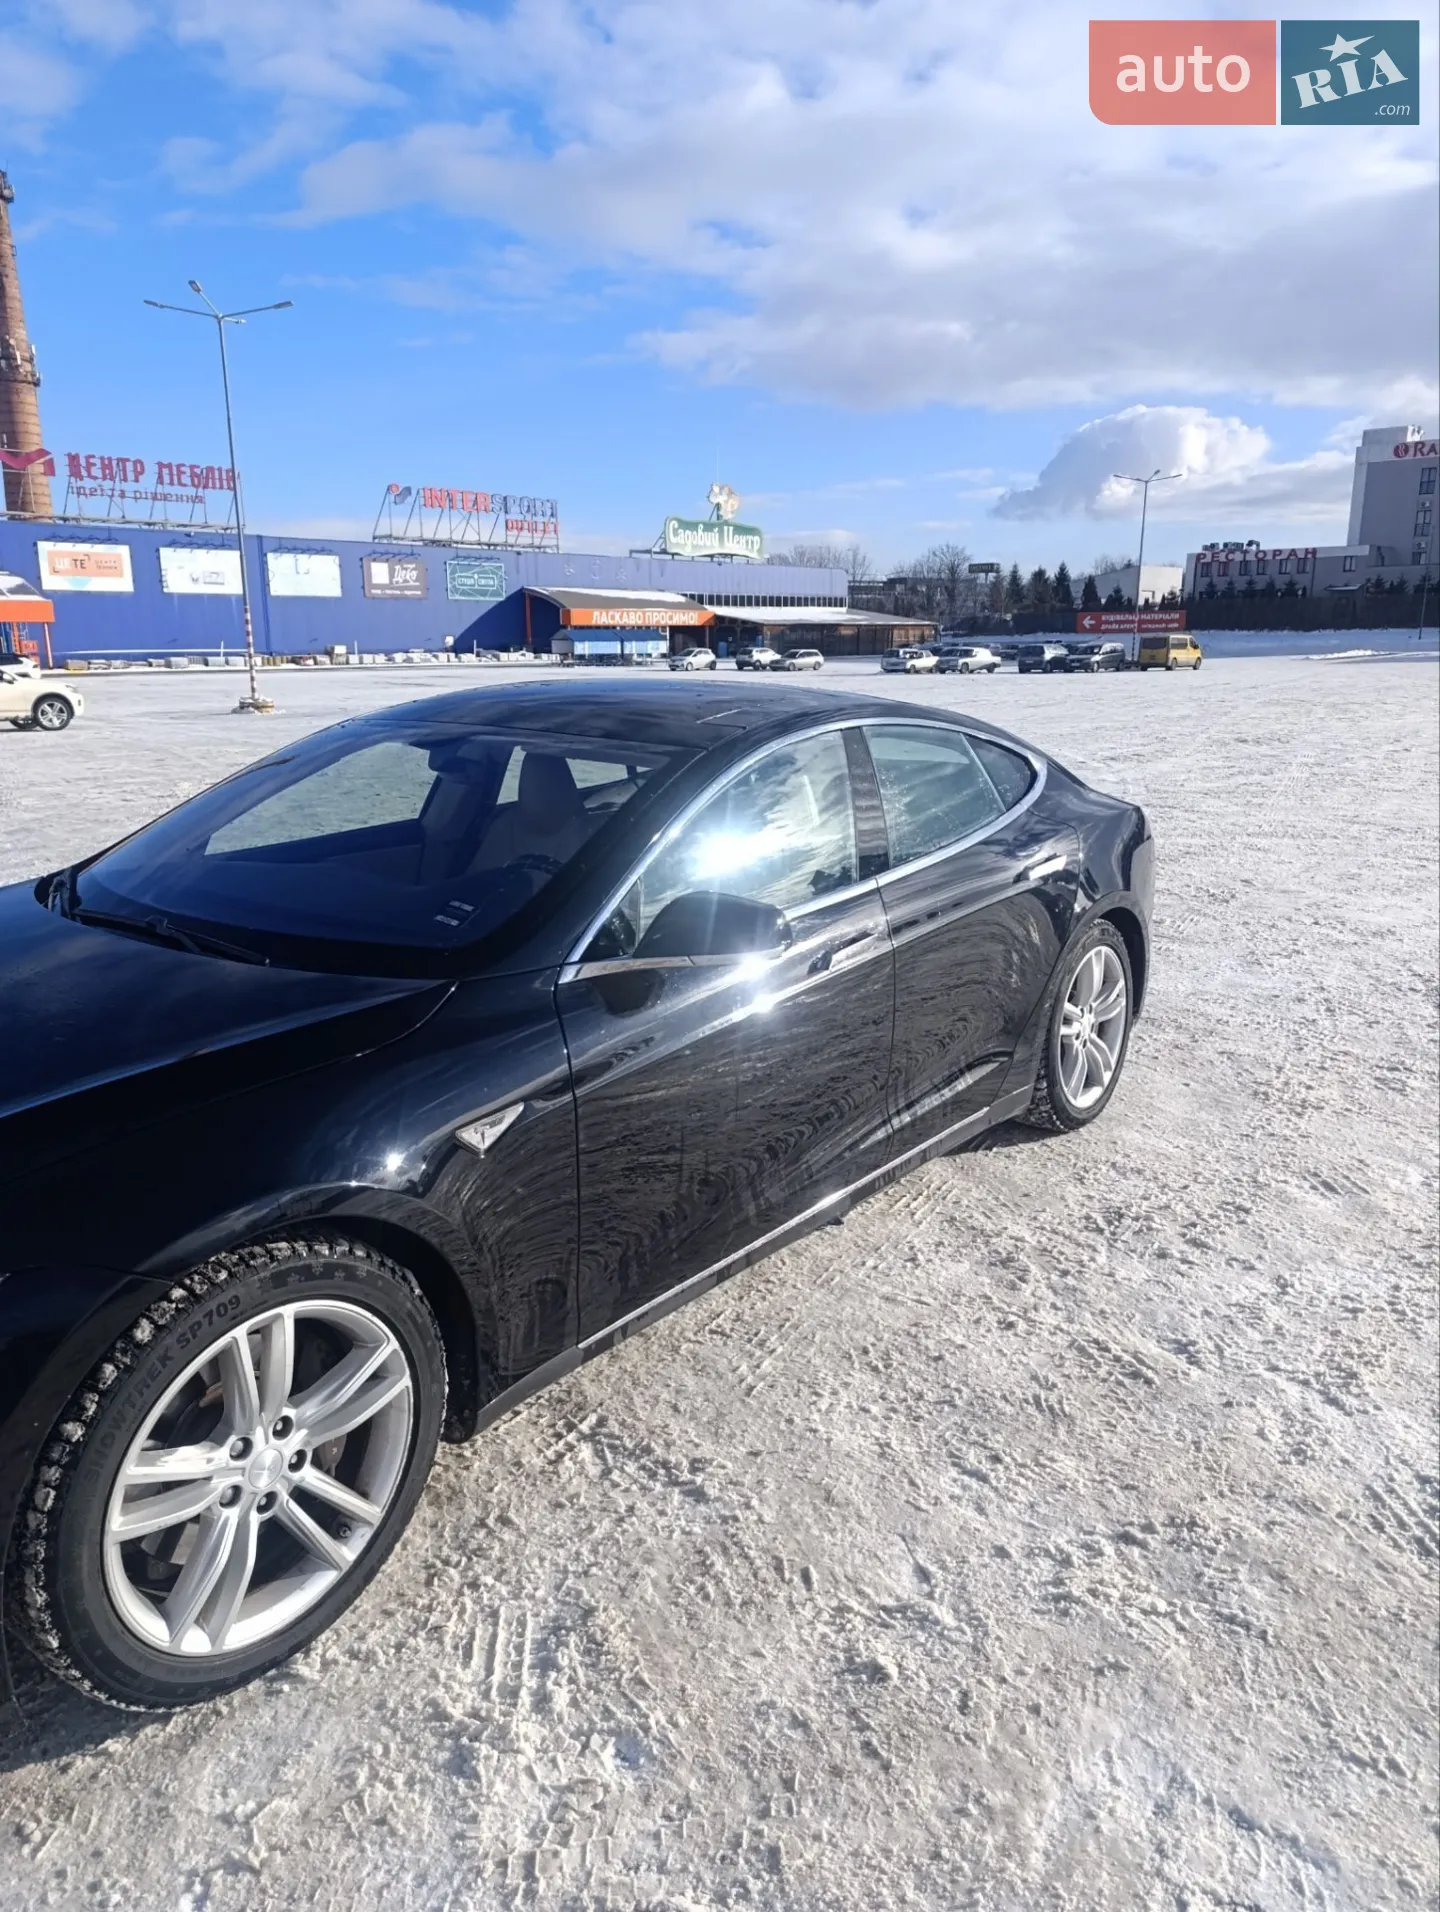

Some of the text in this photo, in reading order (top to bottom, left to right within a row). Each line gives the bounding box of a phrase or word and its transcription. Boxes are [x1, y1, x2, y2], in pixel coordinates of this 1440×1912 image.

[67, 452, 145, 483] ЦЕНТР
[423, 486, 558, 518] INTERSPORT
[669, 520, 761, 552] Садовий Центр
[1196, 548, 1318, 562] РЕСТОРАН
[592, 610, 699, 626] ЛАСКАВО ПРОСИМО!
[175, 1295, 241, 1349] SP709
